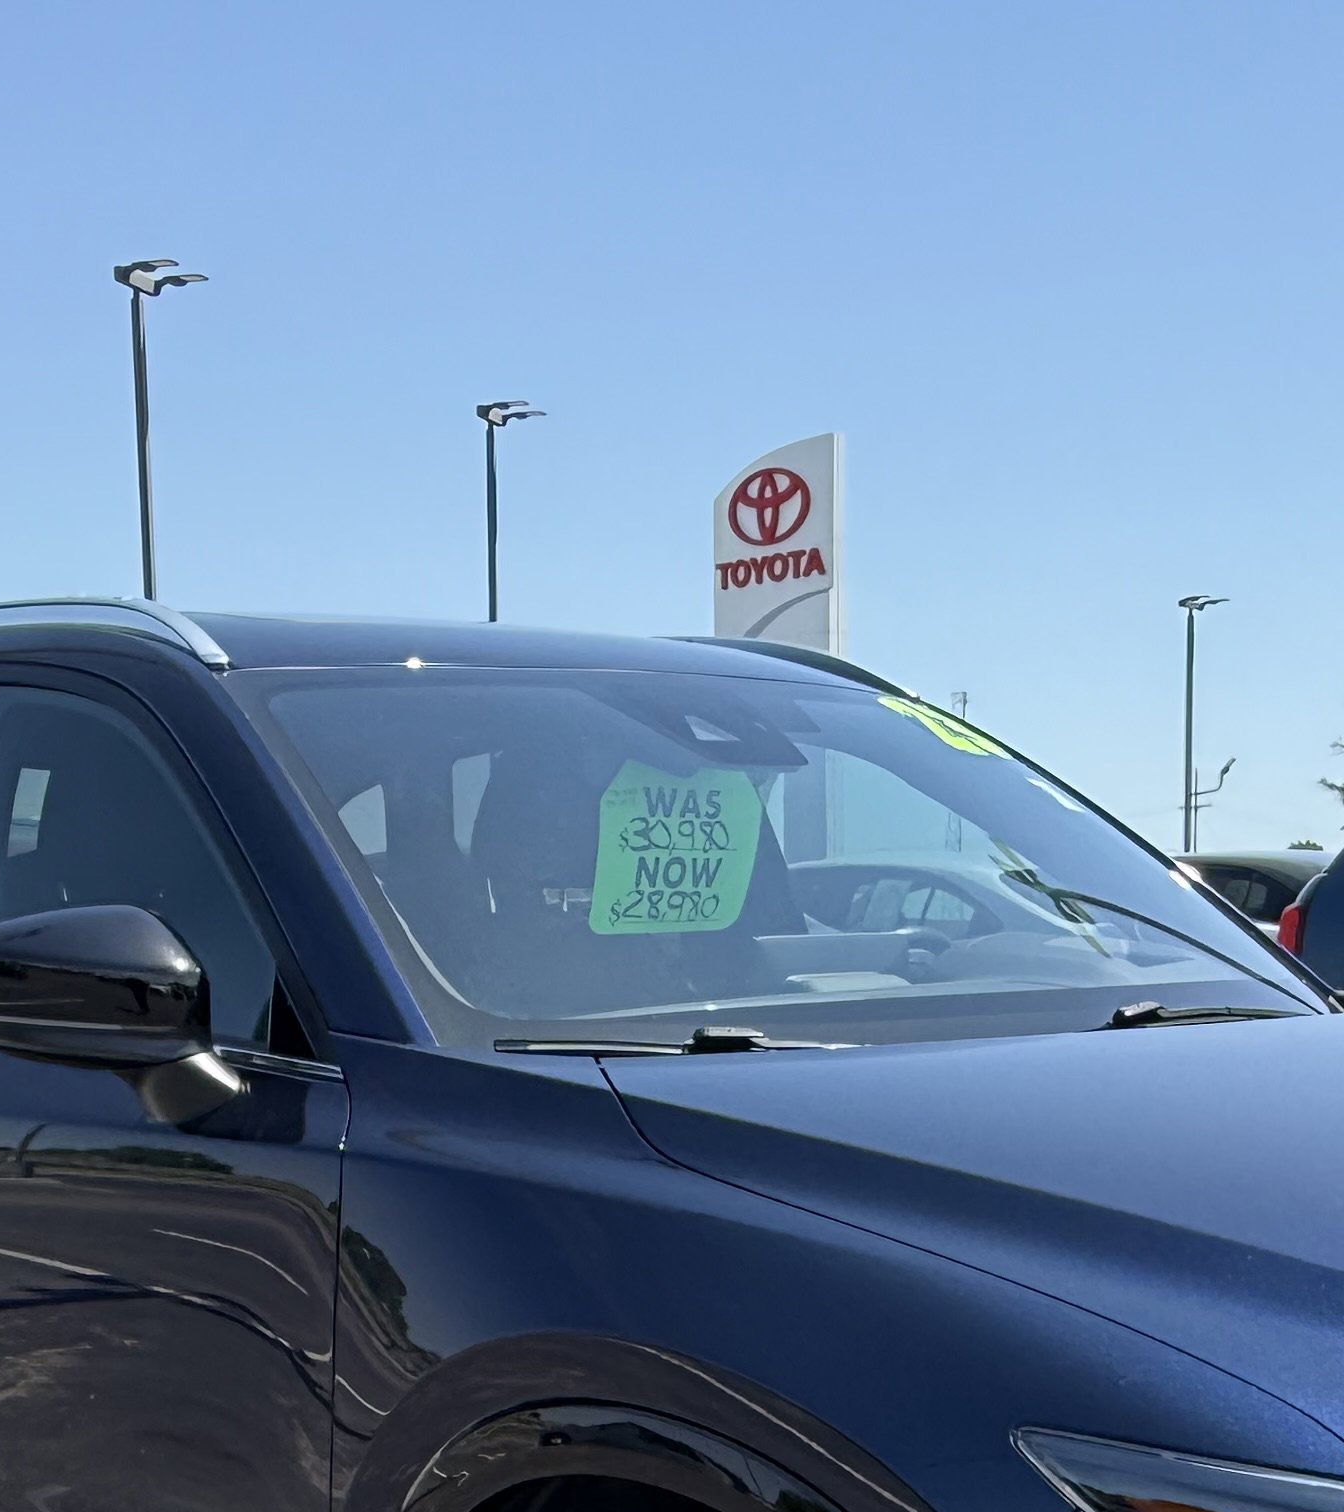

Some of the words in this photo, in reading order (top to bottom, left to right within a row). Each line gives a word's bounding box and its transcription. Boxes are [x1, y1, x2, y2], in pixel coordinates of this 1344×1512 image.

[715, 547, 826, 590] TOYOTA
[642, 786, 722, 820] WAS
[618, 817, 730, 855] $30,980
[634, 856, 723, 889] NOW
[608, 889, 720, 927] $28,980
